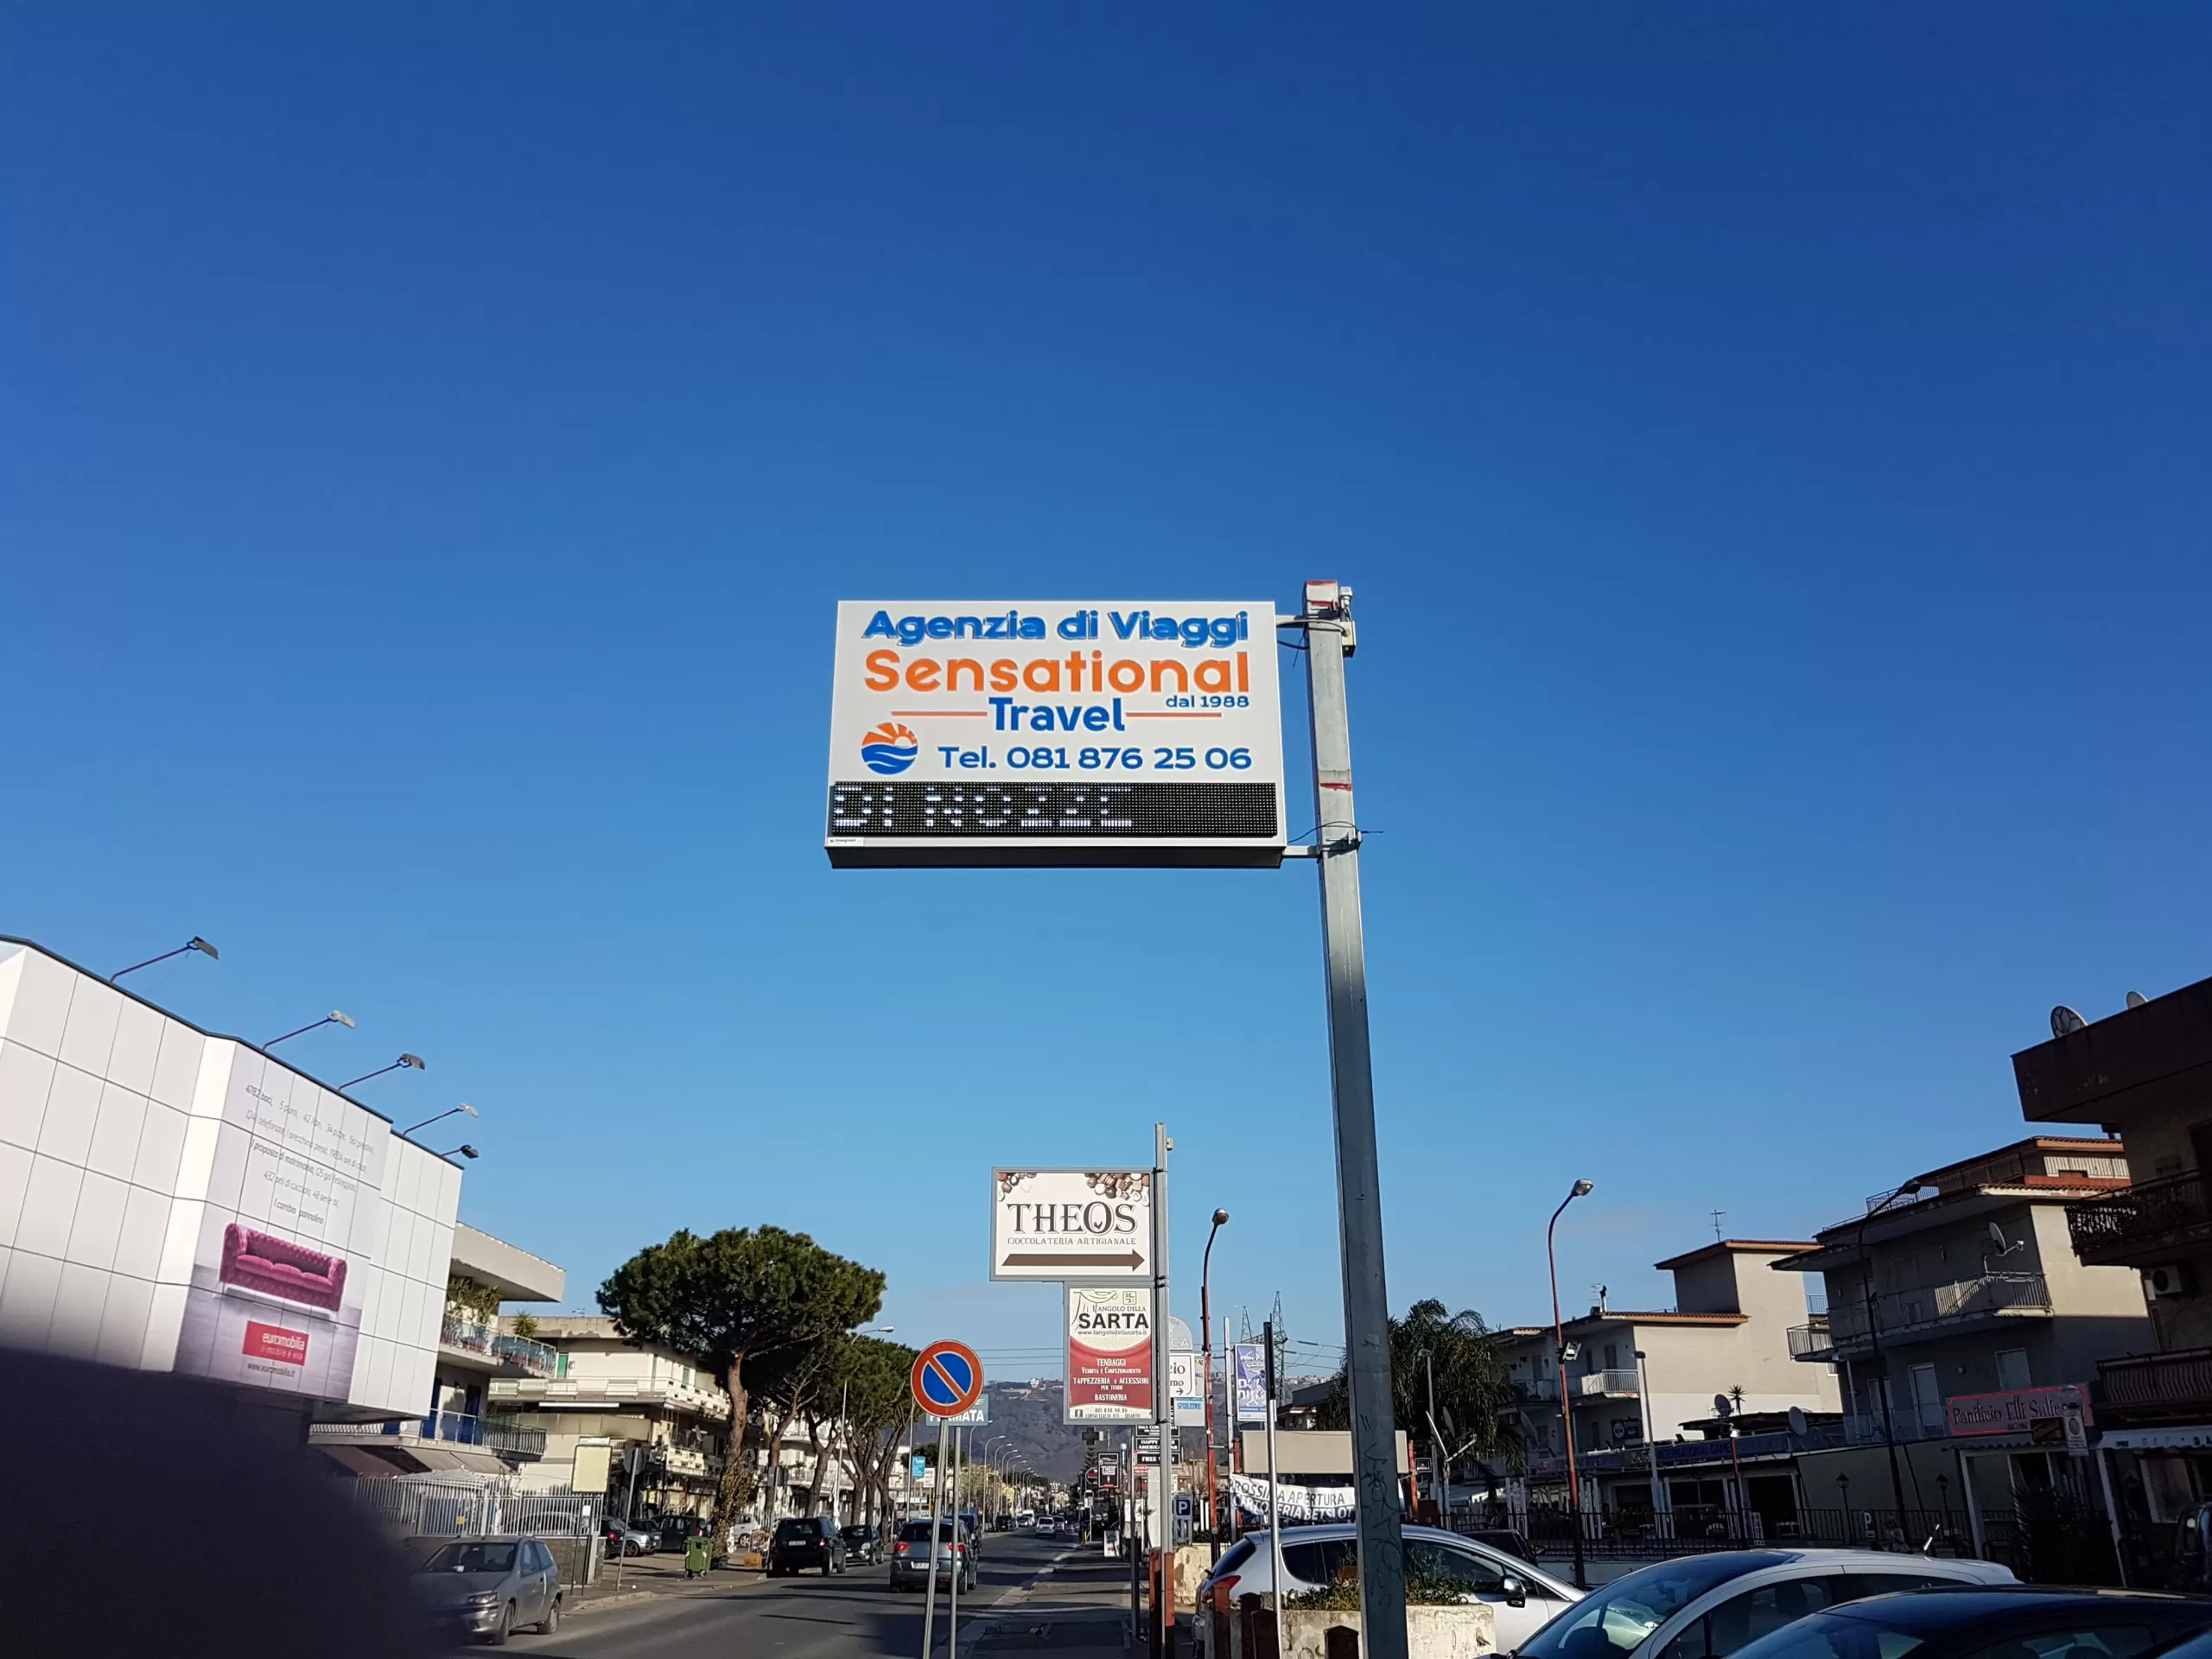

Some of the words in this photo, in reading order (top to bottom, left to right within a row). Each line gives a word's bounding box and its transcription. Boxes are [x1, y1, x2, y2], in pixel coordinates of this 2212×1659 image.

[861, 609, 1046, 646] Agenzia
[1058, 609, 1099, 641] di
[1108, 609, 1249, 648] Viaggi
[863, 648, 1250, 693] Sensational
[1166, 695, 1197, 709] dal
[1200, 696, 1250, 709] 1988
[988, 696, 1127, 733] Travel
[938, 746, 997, 771] Tel.
[1007, 747, 1071, 770] 081
[1077, 747, 1144, 770] 876
[1154, 747, 1197, 770] 25
[1205, 747, 1253, 770] 06
[1006, 1201, 1138, 1236] THEOS
[1007, 1236, 1074, 1245] CIOCCOLATERIA
[1077, 1236, 1137, 1245] ARTIGIANALE
[1077, 1313, 1150, 1330] SARTA
[1096, 1358, 1127, 1367] TENDAGGI
[1952, 1400, 2002, 1425] Panificio
[1287, 1491, 1345, 1506] APERTURA
[1178, 1501, 1188, 1515] P
[1863, 1511, 1872, 1529] P
